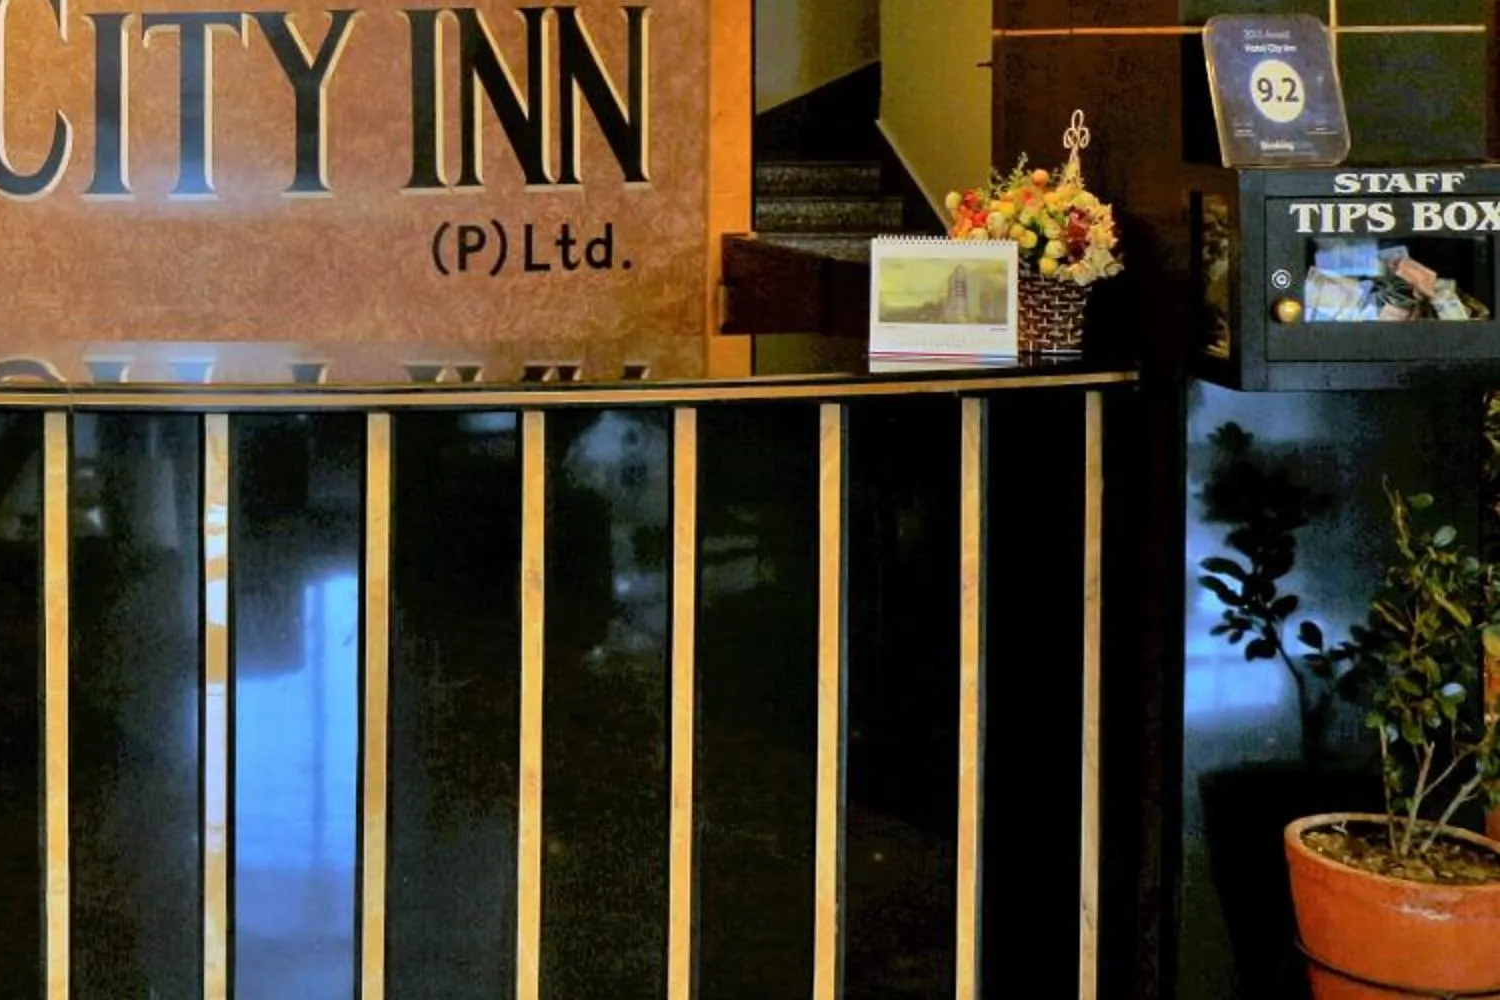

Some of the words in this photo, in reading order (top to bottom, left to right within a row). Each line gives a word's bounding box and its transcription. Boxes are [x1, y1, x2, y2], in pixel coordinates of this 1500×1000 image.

[399, 5, 653, 195] INN
[1257, 77, 1300, 103] 9.2
[1333, 173, 1465, 193] STAFF
[1289, 203, 1396, 233] TIPS
[1411, 201, 1500, 232] BOX
